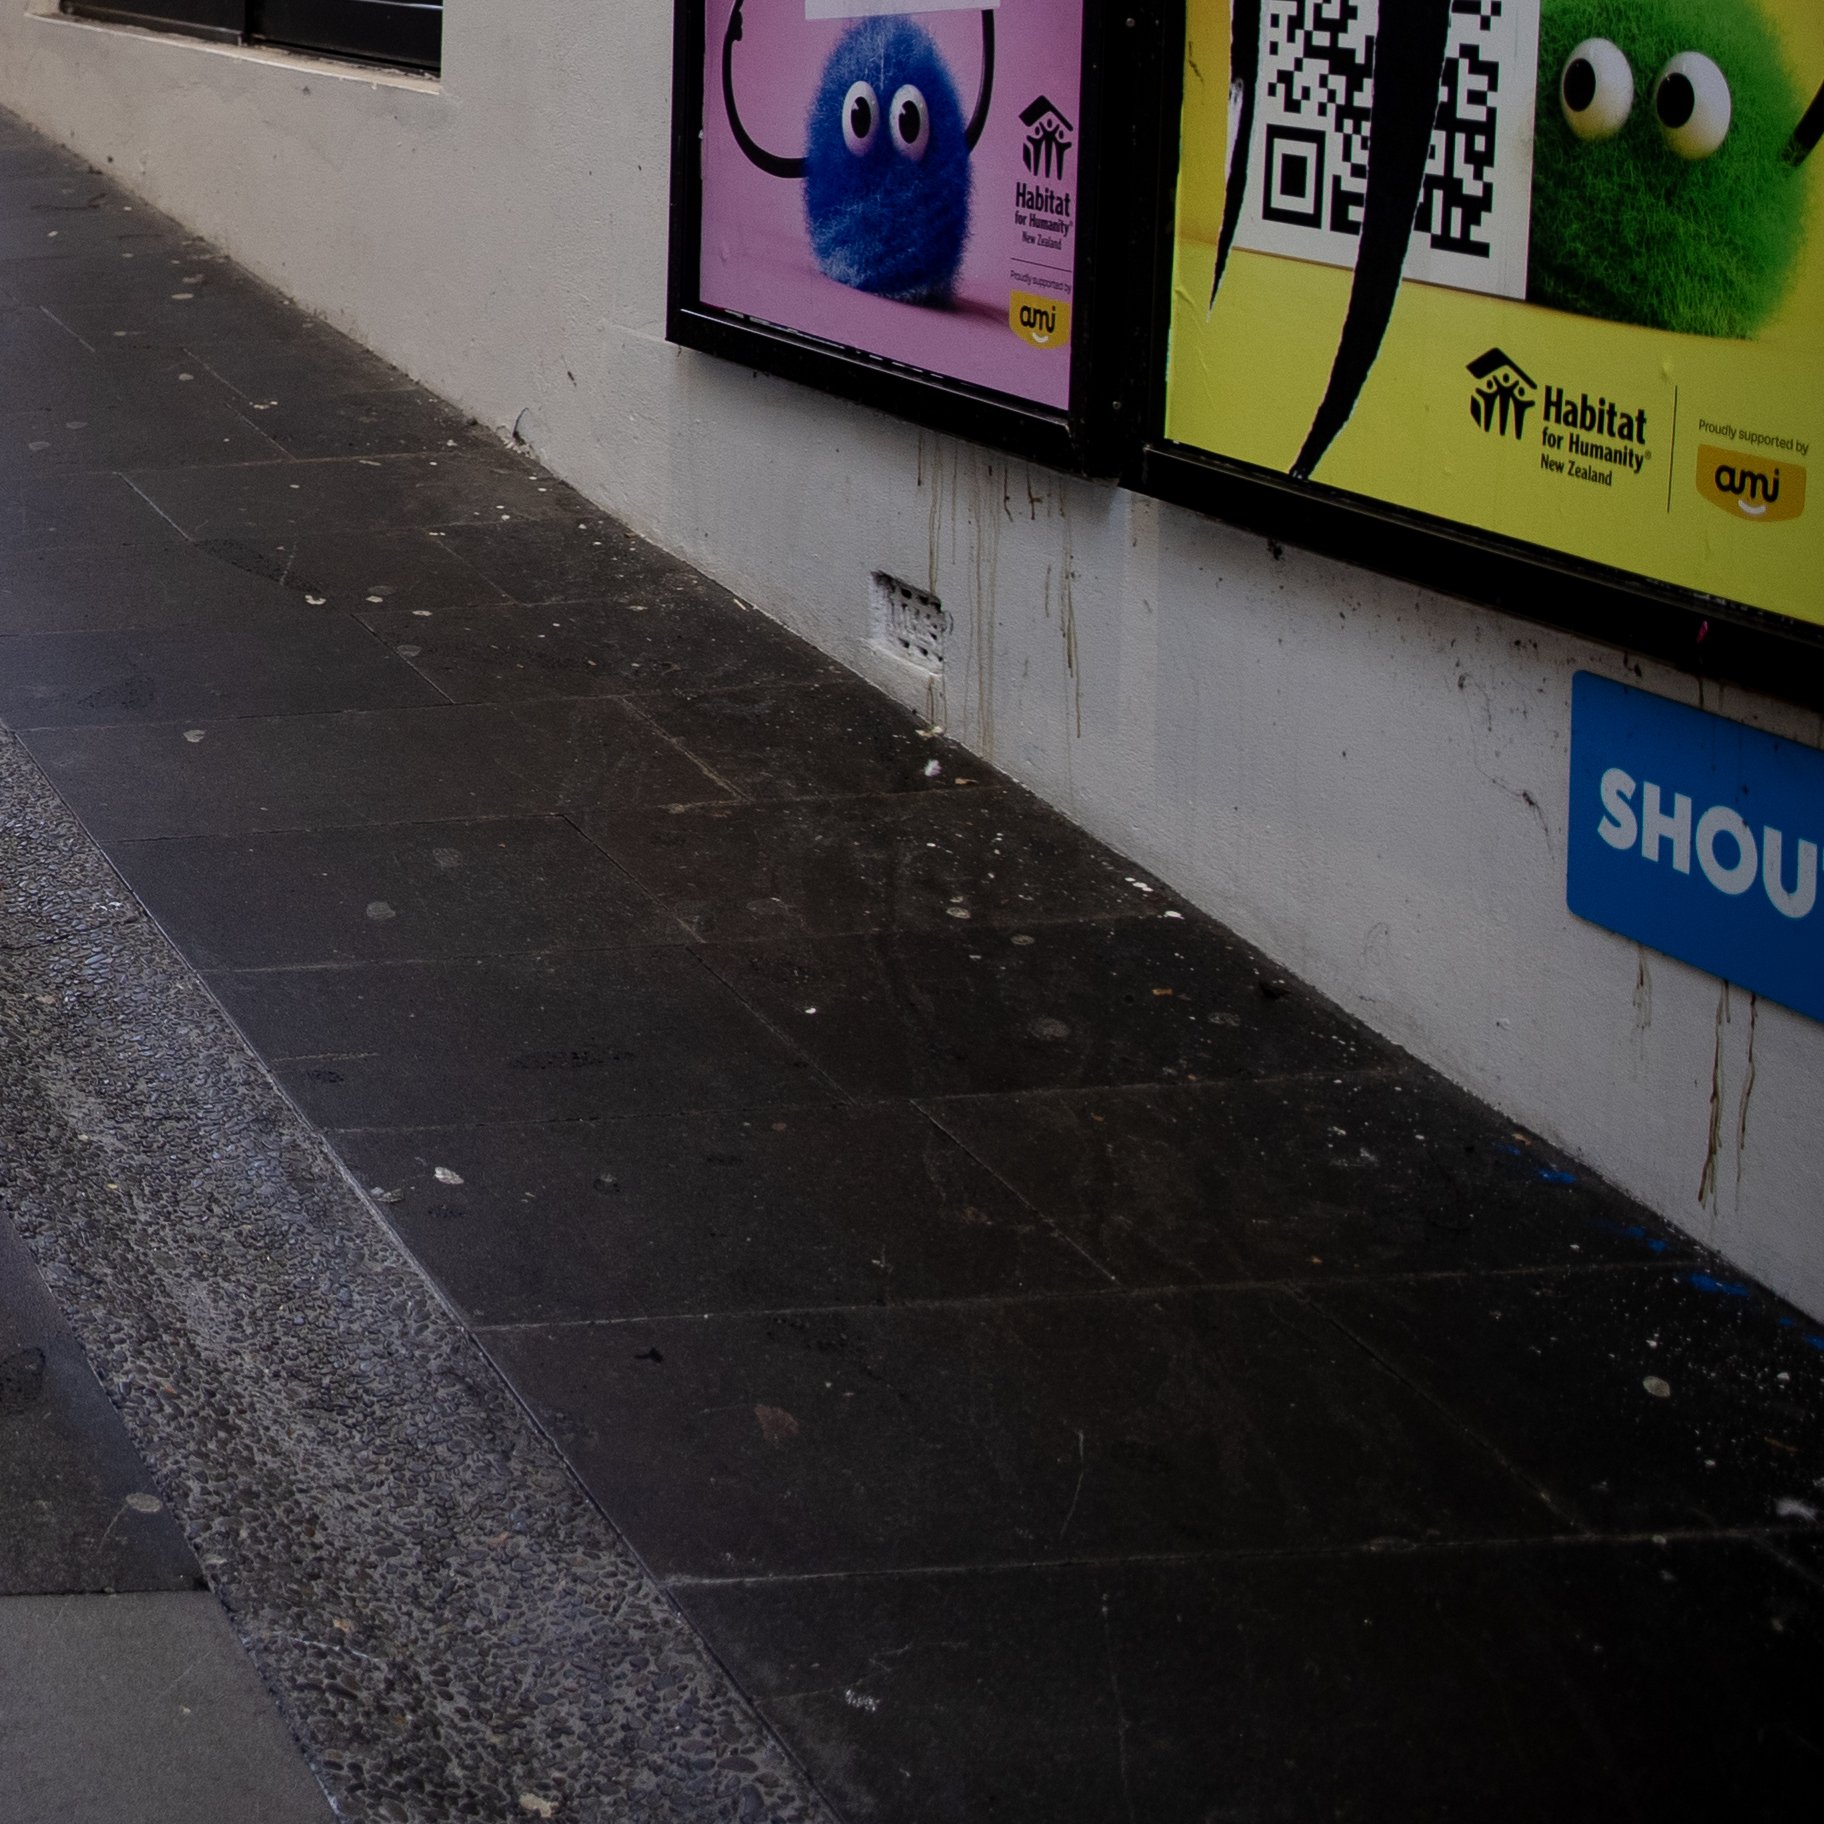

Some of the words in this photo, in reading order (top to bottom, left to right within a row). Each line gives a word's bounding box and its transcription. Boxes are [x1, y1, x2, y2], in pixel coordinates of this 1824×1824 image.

[1015, 181, 1071, 217] Habitat
[1014, 210, 1027, 226] for
[1029, 213, 1071, 237] Humanity
[1021, 231, 1035, 245] New
[1037, 234, 1062, 250] Zealand
[1019, 305, 1056, 334] ami
[1542, 384, 1647, 445] Habitat
[1541, 426, 1564, 450] for
[1568, 431, 1645, 474] Humanity
[1698, 418, 1737, 440] Proudly
[1738, 427, 1794, 451] supported
[1795, 438, 1810, 456] by
[1540, 452, 1565, 474] New
[1567, 459, 1613, 487] Zealand
[1714, 464, 1780, 504] ami
[1597, 766, 1824, 920] SHOU
